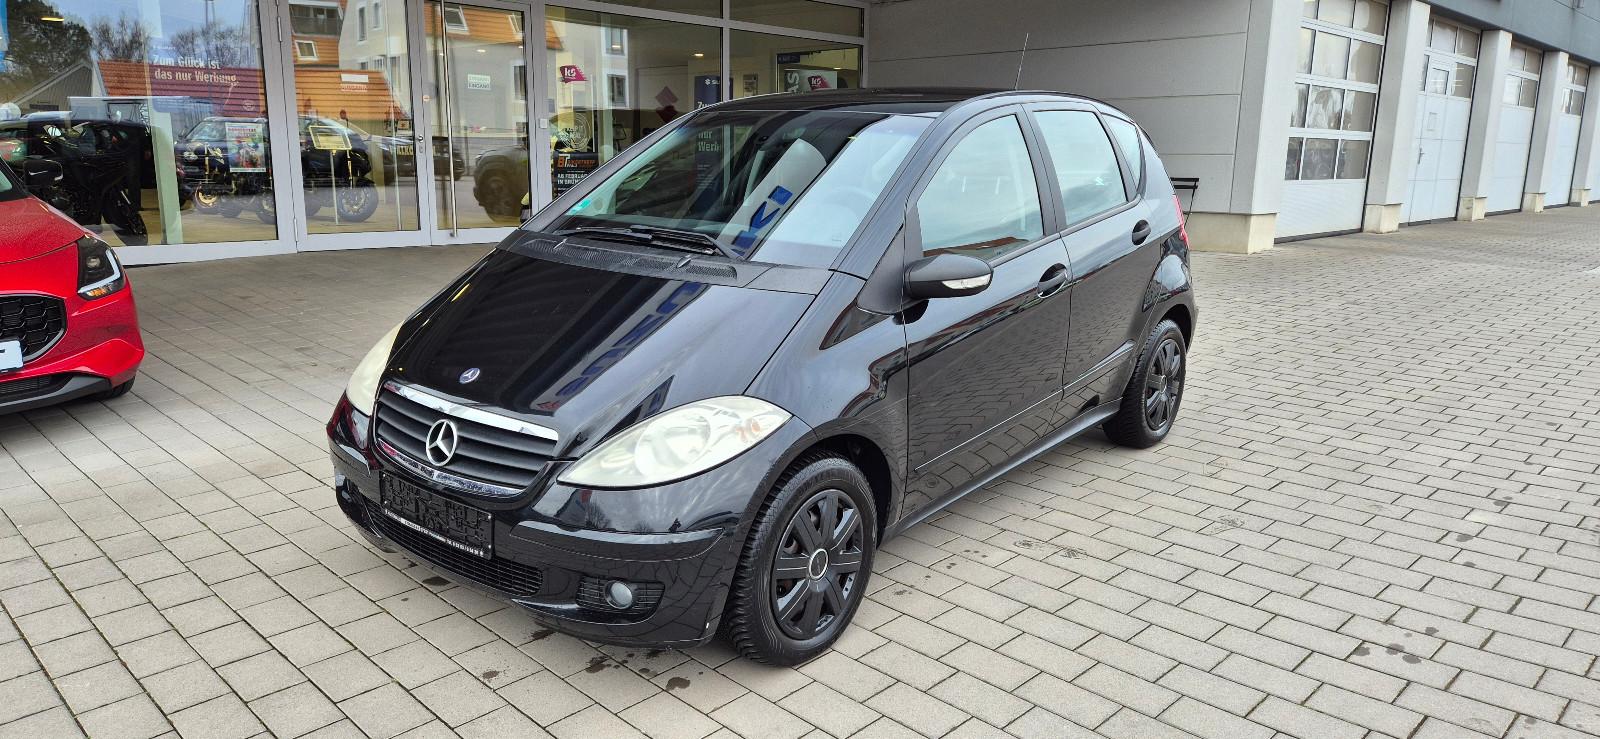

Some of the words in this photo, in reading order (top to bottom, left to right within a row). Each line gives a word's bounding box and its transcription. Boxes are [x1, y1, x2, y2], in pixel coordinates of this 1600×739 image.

[153, 55, 175, 66] Zum
[178, 56, 205, 69] Glück
[208, 57, 221, 69] ist
[155, 68, 173, 80] das
[175, 72, 192, 80] nur
